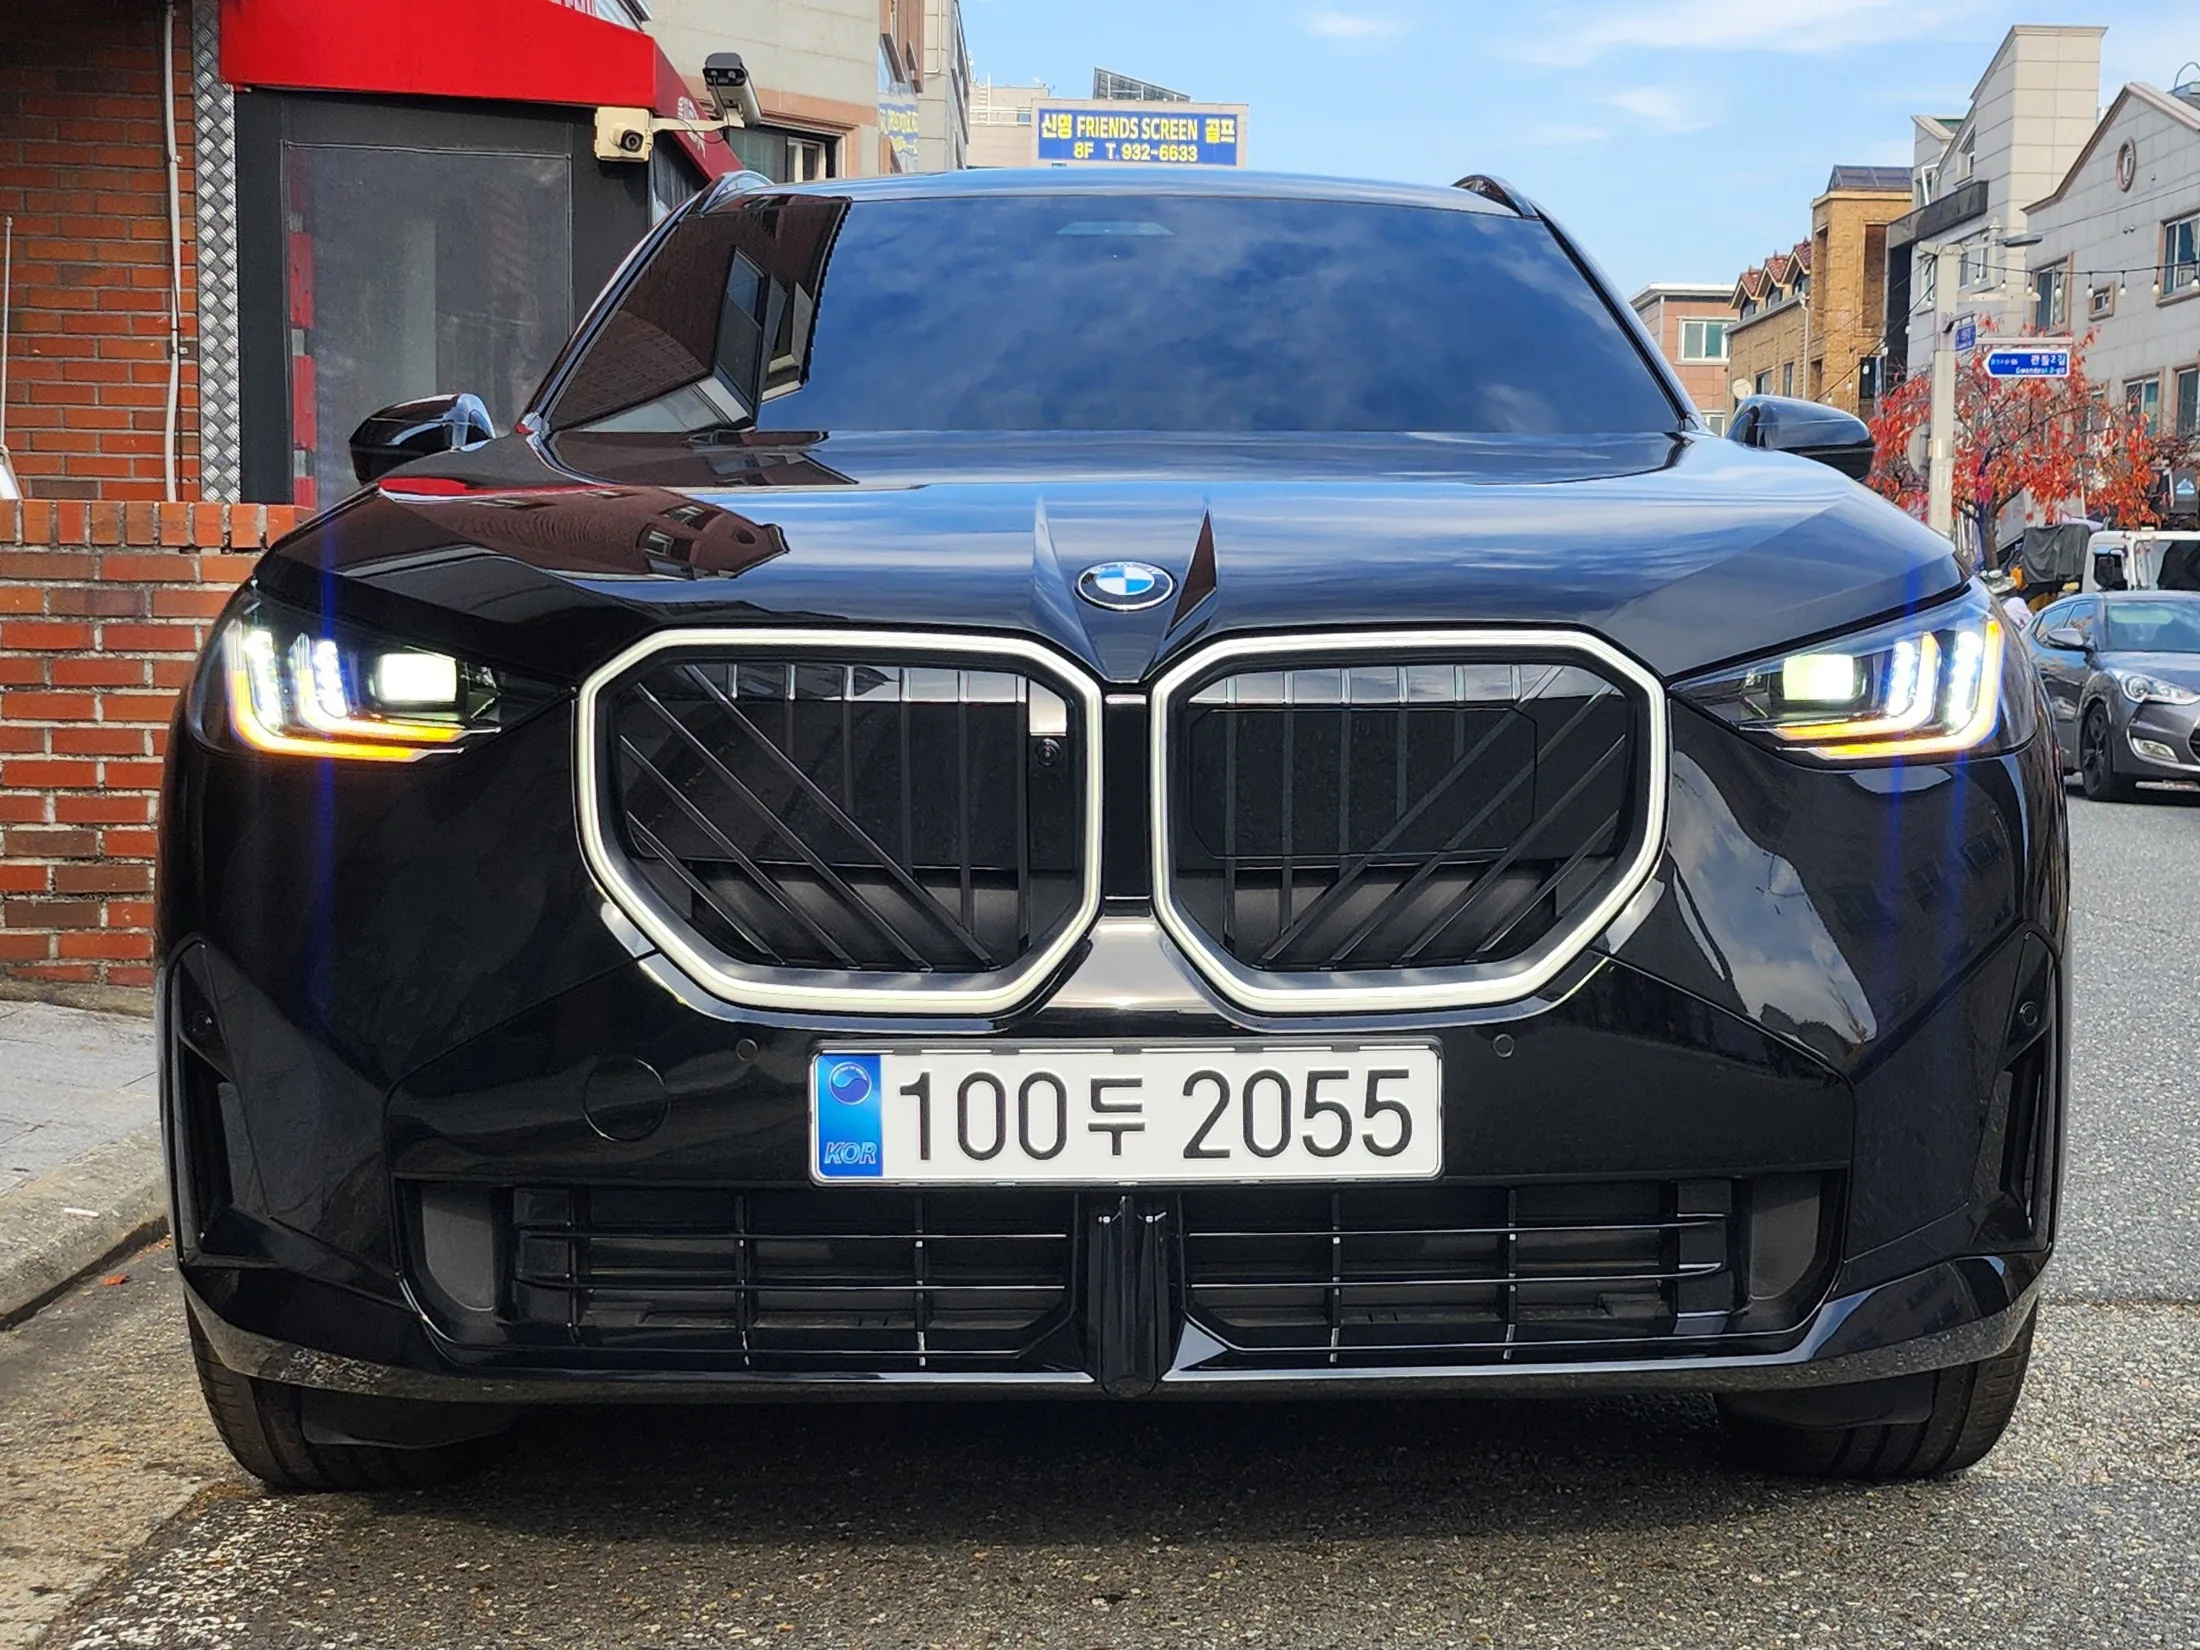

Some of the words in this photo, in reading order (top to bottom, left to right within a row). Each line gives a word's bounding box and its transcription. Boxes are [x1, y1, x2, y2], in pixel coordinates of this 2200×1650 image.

[1076, 115, 1139, 139] FRIENDS
[1141, 118, 1198, 141] SCREEN
[1205, 118, 1235, 144] 골프
[1073, 142, 1094, 159] 8F
[899, 1070, 1146, 1162] 100두
[1181, 1068, 1413, 1160] 2055
[824, 1141, 876, 1164] KOR
